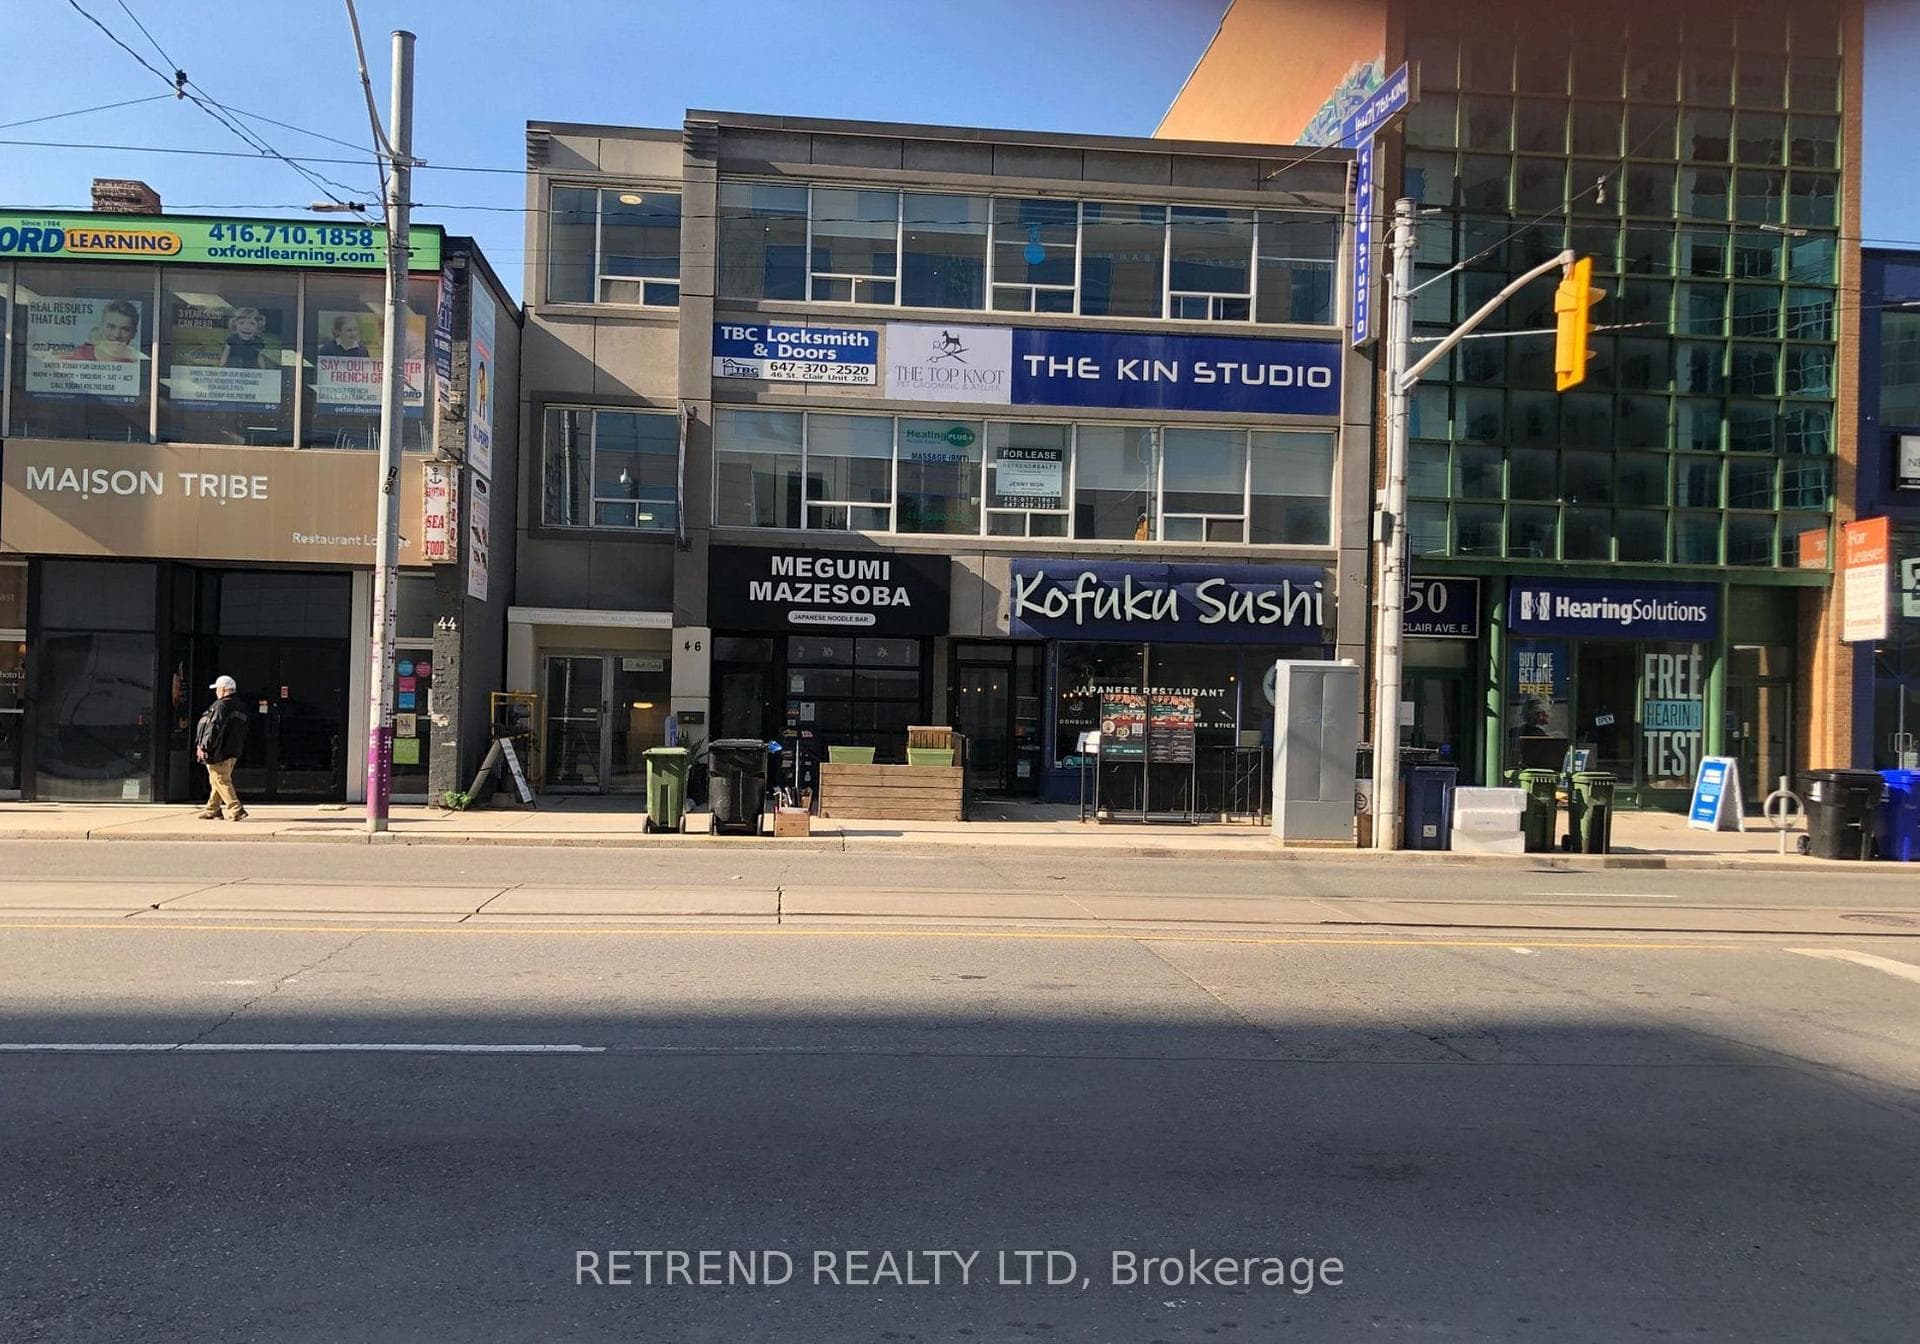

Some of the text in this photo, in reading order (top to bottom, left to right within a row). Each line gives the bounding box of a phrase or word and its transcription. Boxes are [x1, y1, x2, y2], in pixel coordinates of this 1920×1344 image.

[70, 233, 173, 250] LEARNING
[208, 224, 374, 247] 416.710.1858
[208, 244, 375, 264] oxfordlearning.com
[1358, 243, 1366, 334] STUDIO
[54, 302, 94, 314] RESULTS
[30, 313, 78, 326] THAT LAST
[721, 326, 869, 346] TBC Locksmith
[752, 343, 837, 360] & Doors
[321, 360, 340, 370] SAY
[770, 362, 869, 376] 647-370-2520
[1023, 355, 1332, 388] THE KIN STUDIO
[330, 371, 368, 383] FRENCH
[895, 366, 1005, 384] THE TOP KNOT
[1003, 450, 1057, 460] FOR LEASE
[26, 466, 268, 505] MAISON TRIBE
[426, 515, 445, 529] SEA
[292, 532, 360, 545] Restaurant
[1848, 530, 1868, 546] For
[425, 540, 445, 556] FOOD
[771, 556, 890, 580] MEGUMI
[750, 581, 911, 607] MAZESOBA
[1015, 570, 1323, 626] Kofuku Sushi
[1404, 582, 1448, 614] 50
[794, 614, 826, 622] JAPANESE
[827, 615, 854, 623] NOODLE
[1556, 596, 1707, 625] HearingSolutions
[438, 616, 457, 630] 44
[1402, 622, 1471, 634] CLAIR AVE. E.
[1518, 652, 1553, 668] BUY ONE
[1518, 668, 1553, 684] GET ONE
[1644, 654, 1703, 700] FREE
[1073, 685, 1225, 697] JAPANESE RESTAURANT
[1518, 684, 1554, 695] FREE
[1644, 731, 1701, 776] TEST
